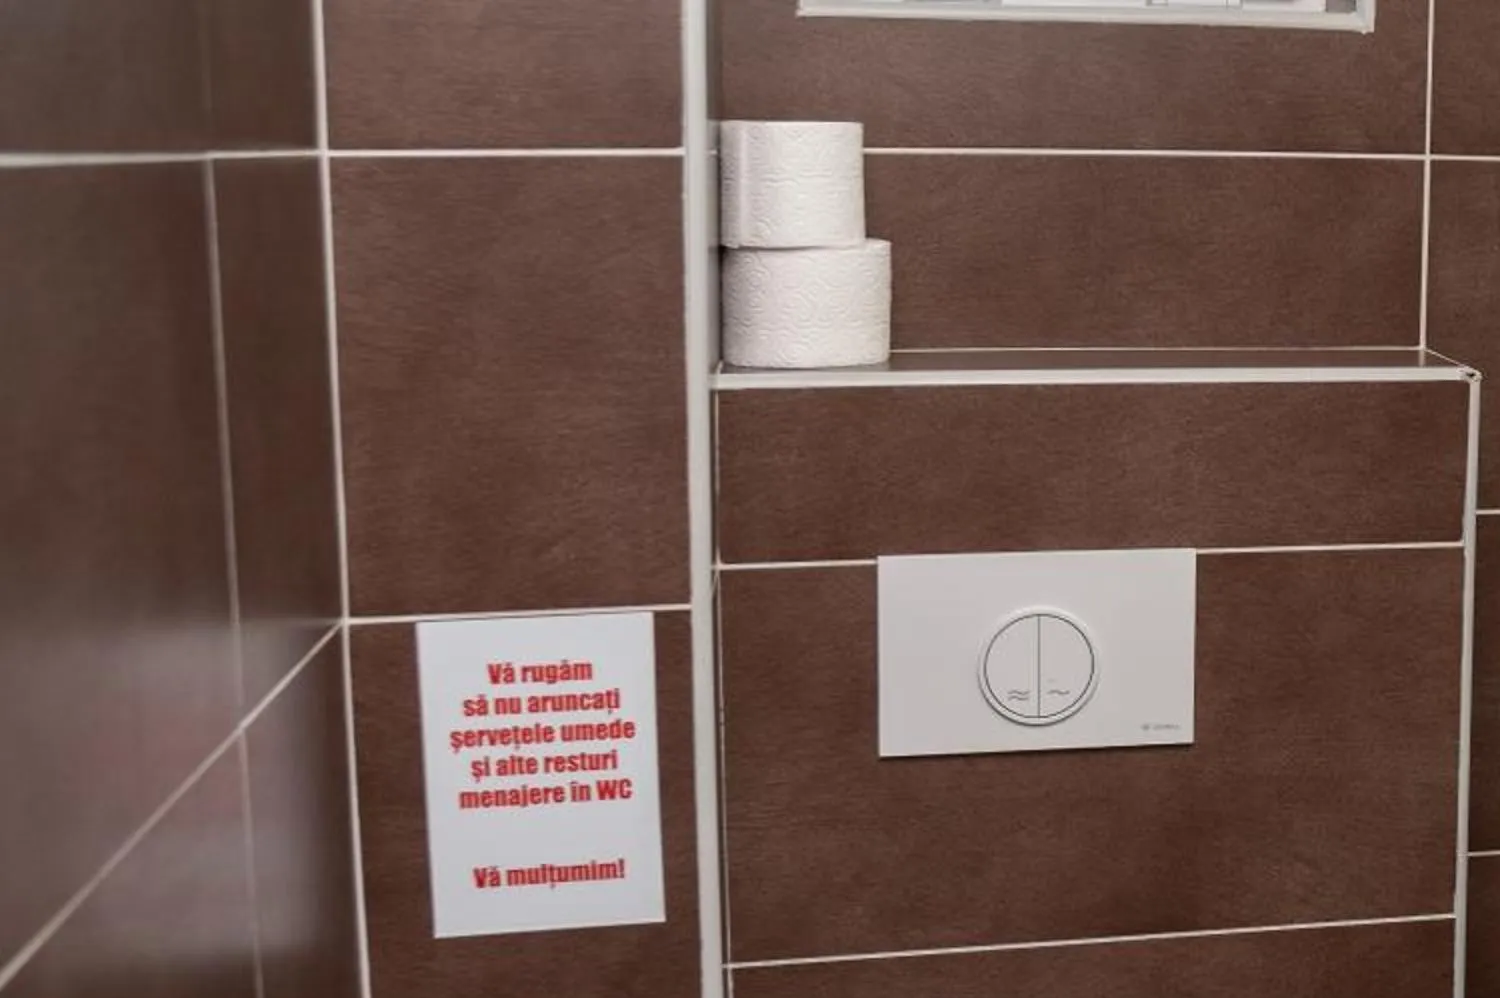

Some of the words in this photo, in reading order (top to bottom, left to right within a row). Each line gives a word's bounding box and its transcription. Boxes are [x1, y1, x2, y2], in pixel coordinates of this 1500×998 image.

[488, 662, 516, 685] Vă
[520, 660, 594, 684] rugăm
[463, 694, 489, 717] să
[494, 696, 522, 716] nu
[526, 687, 621, 715] aruncați
[559, 719, 637, 743] umede
[495, 755, 539, 777] alte
[543, 750, 618, 773] resturi
[458, 784, 566, 809] menajere
[570, 781, 592, 802] în
[595, 777, 633, 801] WC
[472, 866, 502, 889] Vă
[505, 859, 626, 888] mulțumim!
